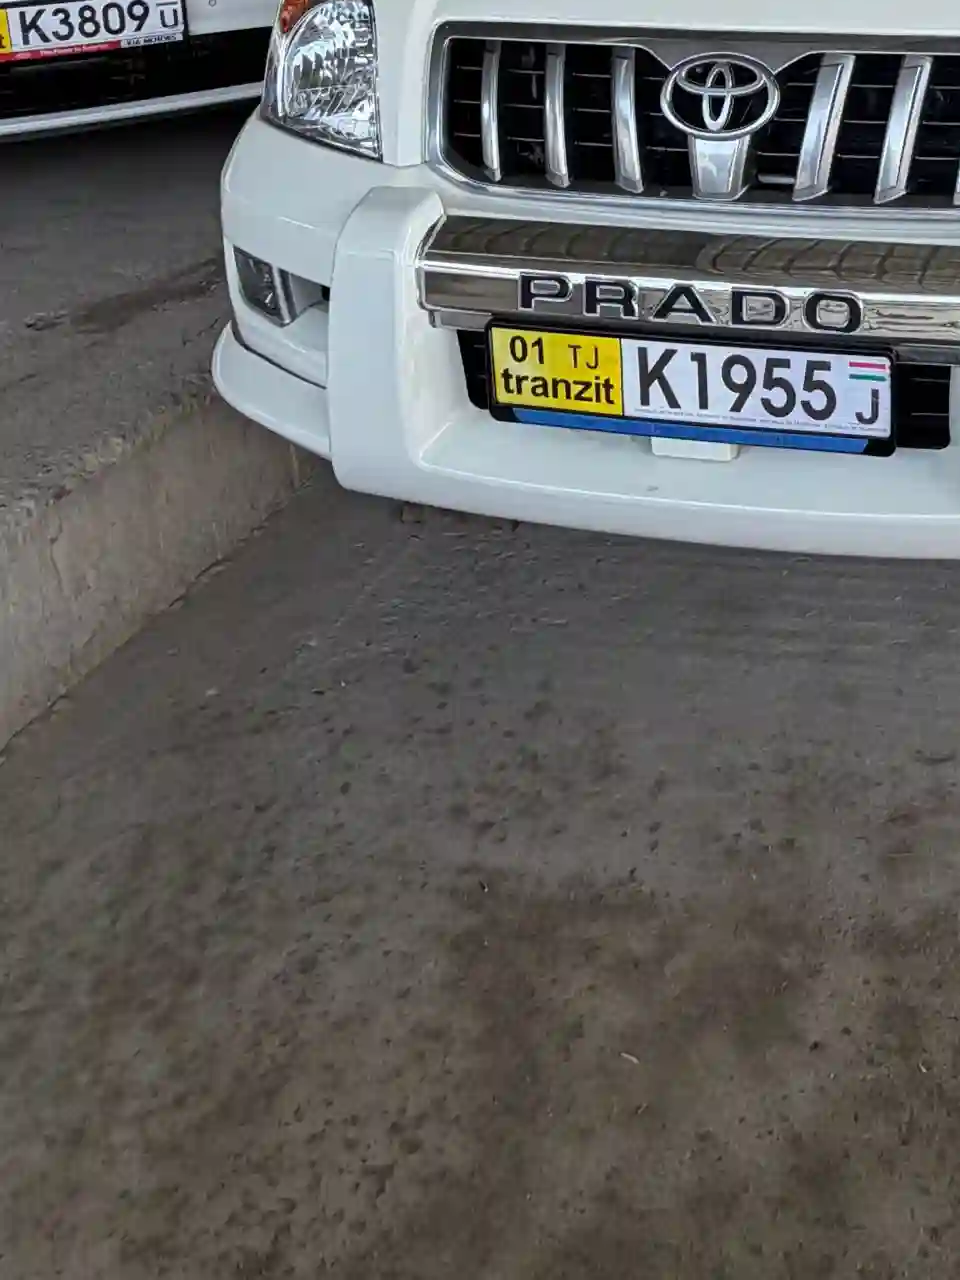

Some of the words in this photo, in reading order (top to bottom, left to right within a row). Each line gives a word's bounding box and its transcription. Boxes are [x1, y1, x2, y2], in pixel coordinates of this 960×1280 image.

[19, 0, 150, 46] K3809
[517, 271, 864, 334] PRADO
[509, 335, 545, 365] 01
[501, 367, 615, 405] tranzit
[637, 346, 837, 421] K1955
[855, 387, 880, 425] J
